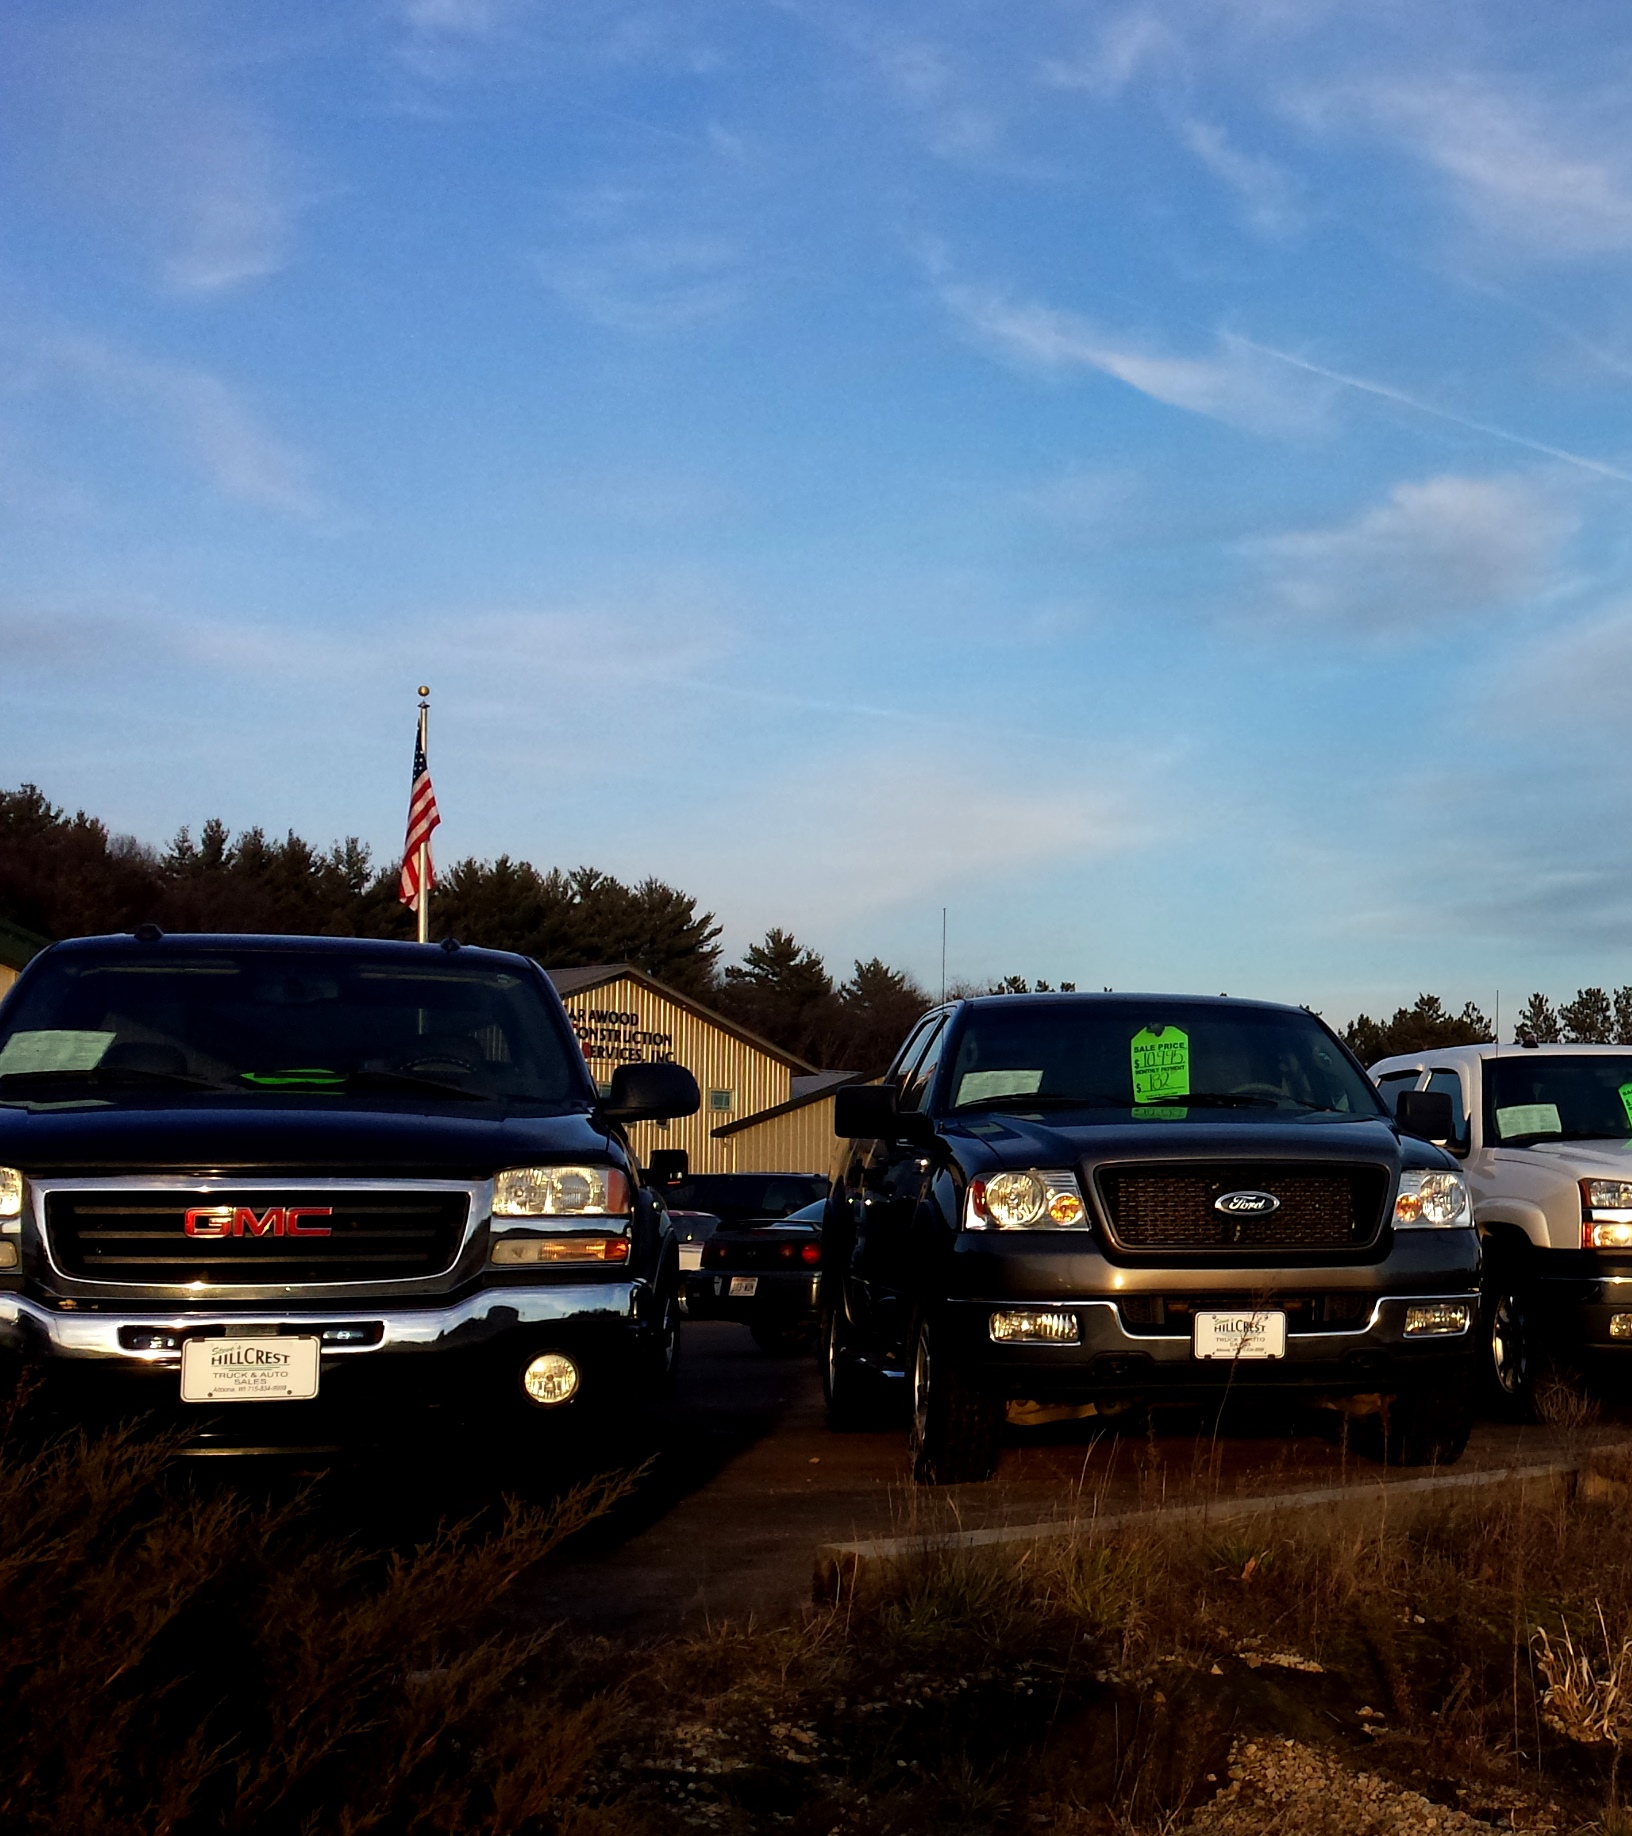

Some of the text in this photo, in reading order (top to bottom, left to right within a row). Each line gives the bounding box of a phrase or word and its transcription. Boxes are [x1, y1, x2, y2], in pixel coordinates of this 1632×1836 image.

[572, 1023, 673, 1047] ONSTRUCTION
[1134, 1042, 1185, 1054] SALE PRICE
[1229, 1195, 1266, 1211] Ford
[184, 1206, 333, 1239] GMC
[211, 1347, 290, 1365] HILLCREST
